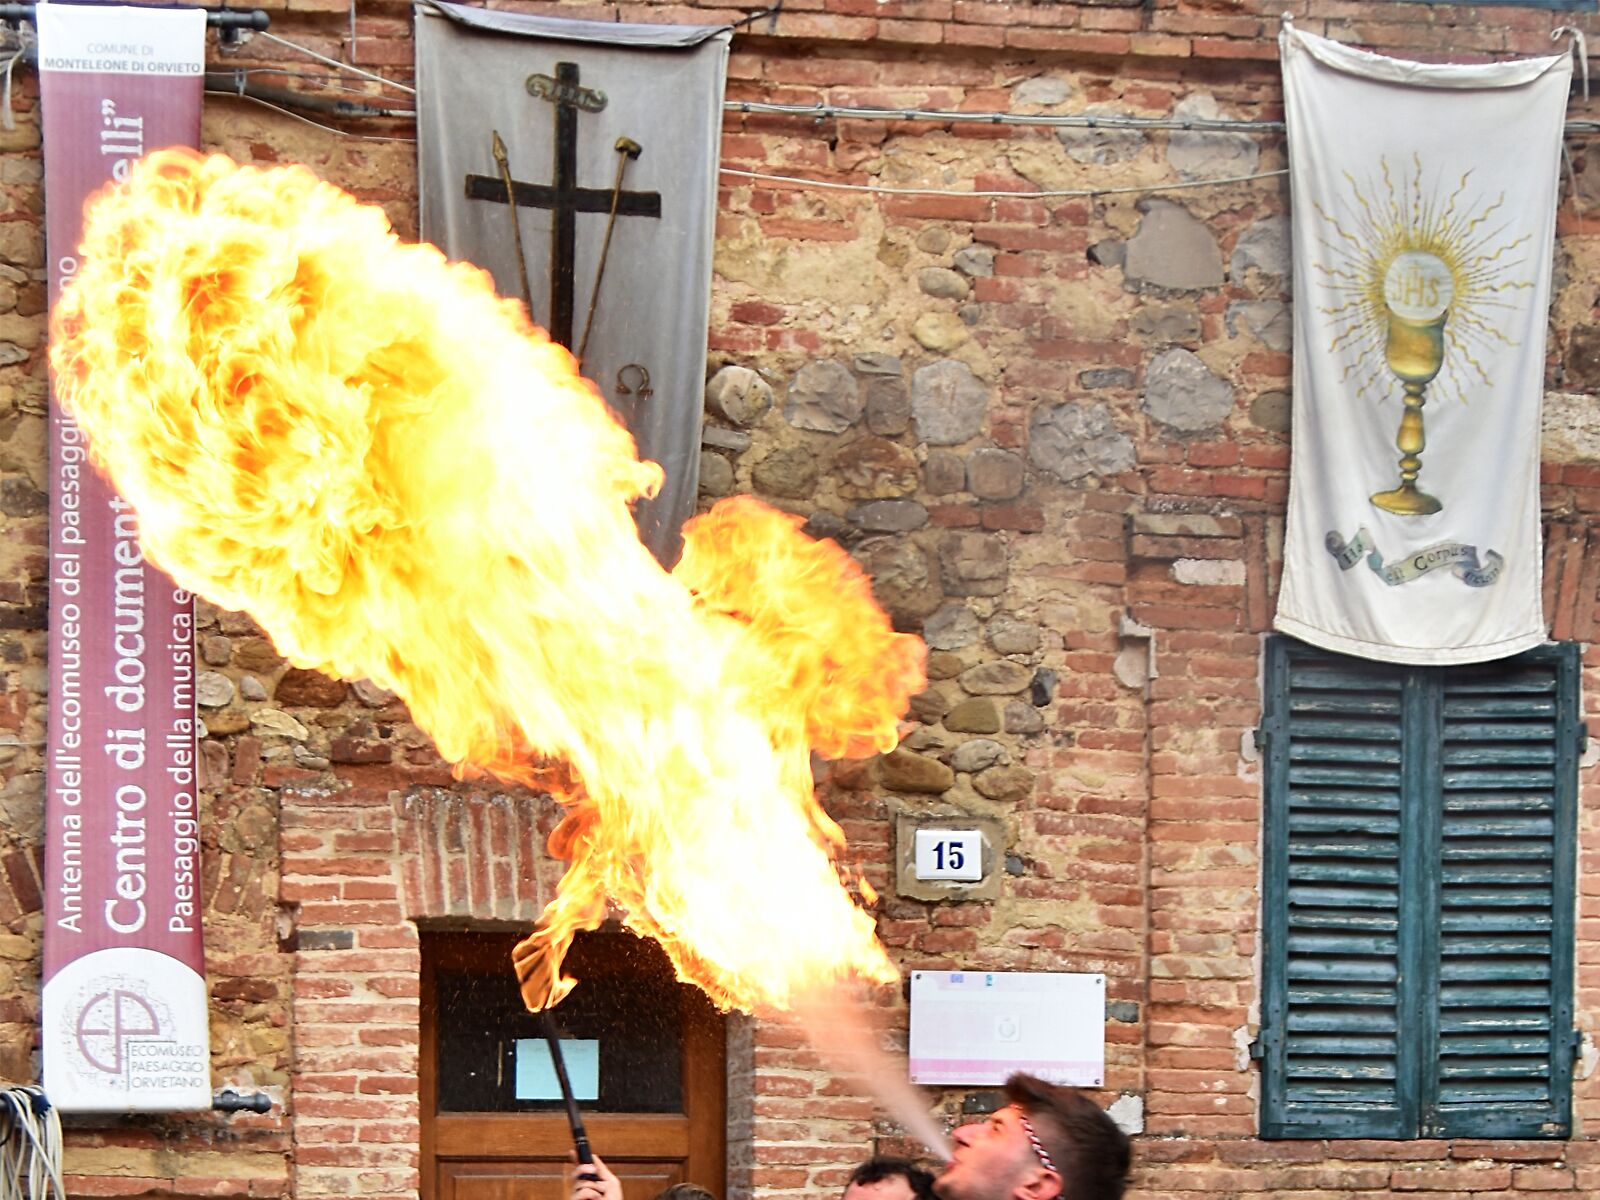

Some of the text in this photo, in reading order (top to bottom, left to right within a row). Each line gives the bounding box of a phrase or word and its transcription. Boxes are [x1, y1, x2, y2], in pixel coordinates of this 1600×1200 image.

[44, 57, 200, 73] MONTELEONE DI ORVIETO
[86, 42, 154, 56] COMUNE DI
[55, 553, 81, 596] del
[1413, 547, 1468, 572] Corpus
[104, 495, 145, 712] document
[167, 613, 192, 709] musica
[55, 603, 82, 806] dell'ecomuseo
[104, 728, 146, 770] di
[167, 718, 192, 785] della
[57, 814, 82, 933] Antenna
[105, 785, 147, 934] Centro
[168, 792, 198, 932] Paesaggio
[932, 841, 964, 870] 15
[131, 1045, 204, 1057] ECOMUSEO
[131, 1061, 204, 1073] PAESAGGIO
[131, 1077, 204, 1089] ORVIETANO
